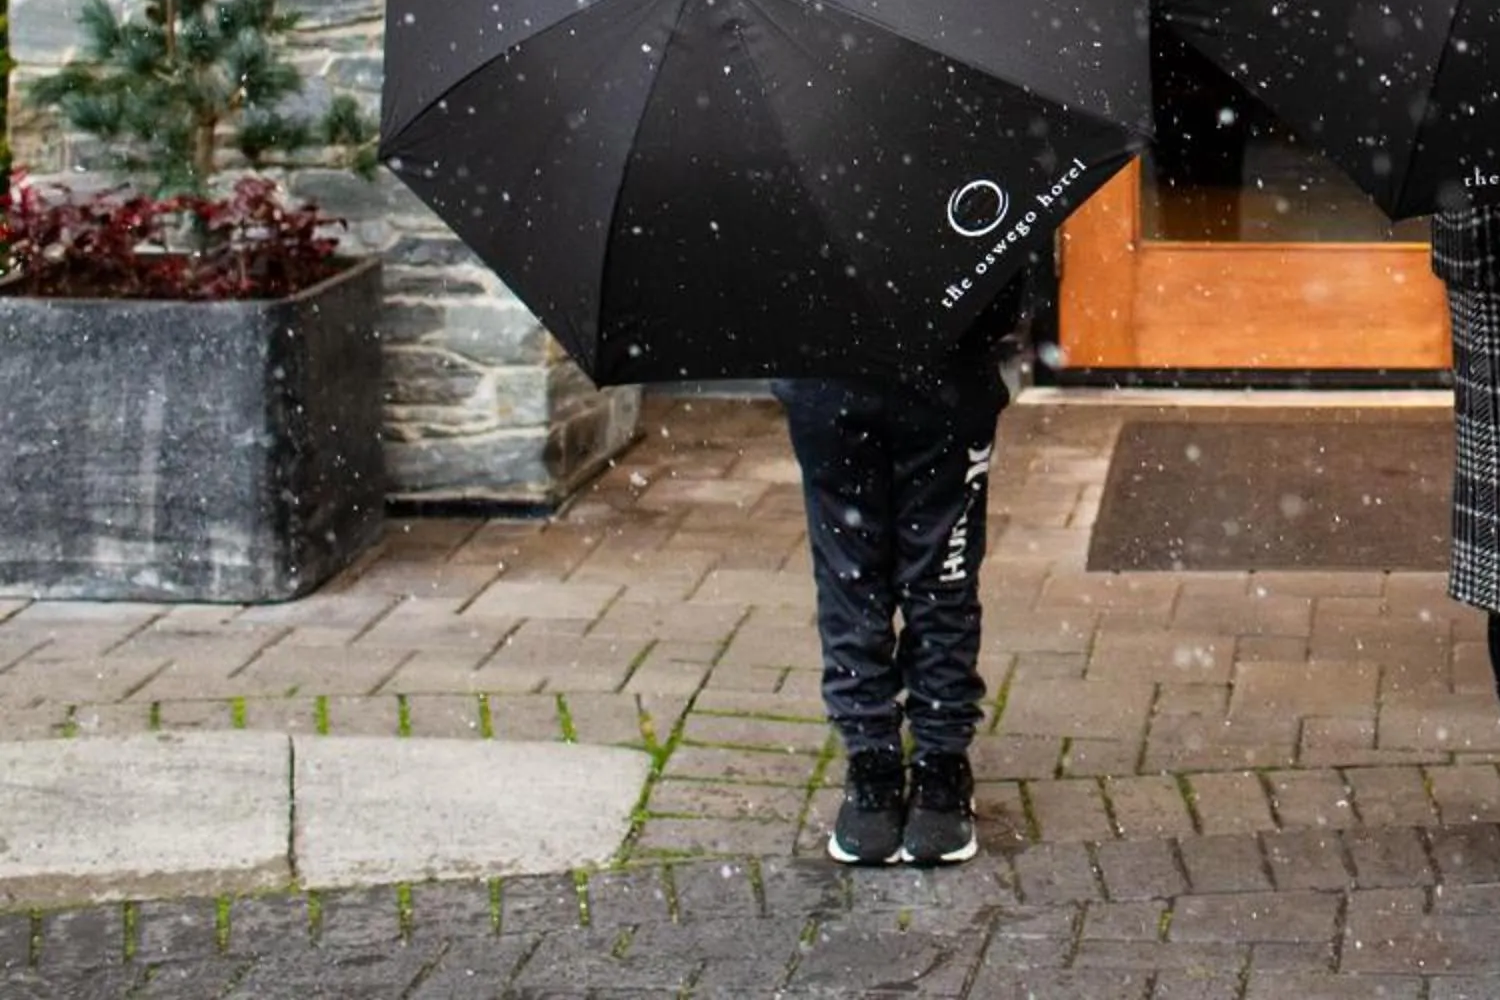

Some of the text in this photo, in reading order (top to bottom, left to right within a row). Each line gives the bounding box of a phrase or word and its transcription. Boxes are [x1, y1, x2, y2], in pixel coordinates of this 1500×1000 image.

[1463, 166, 1500, 188] the
[941, 157, 1088, 308] the oswego hotel
